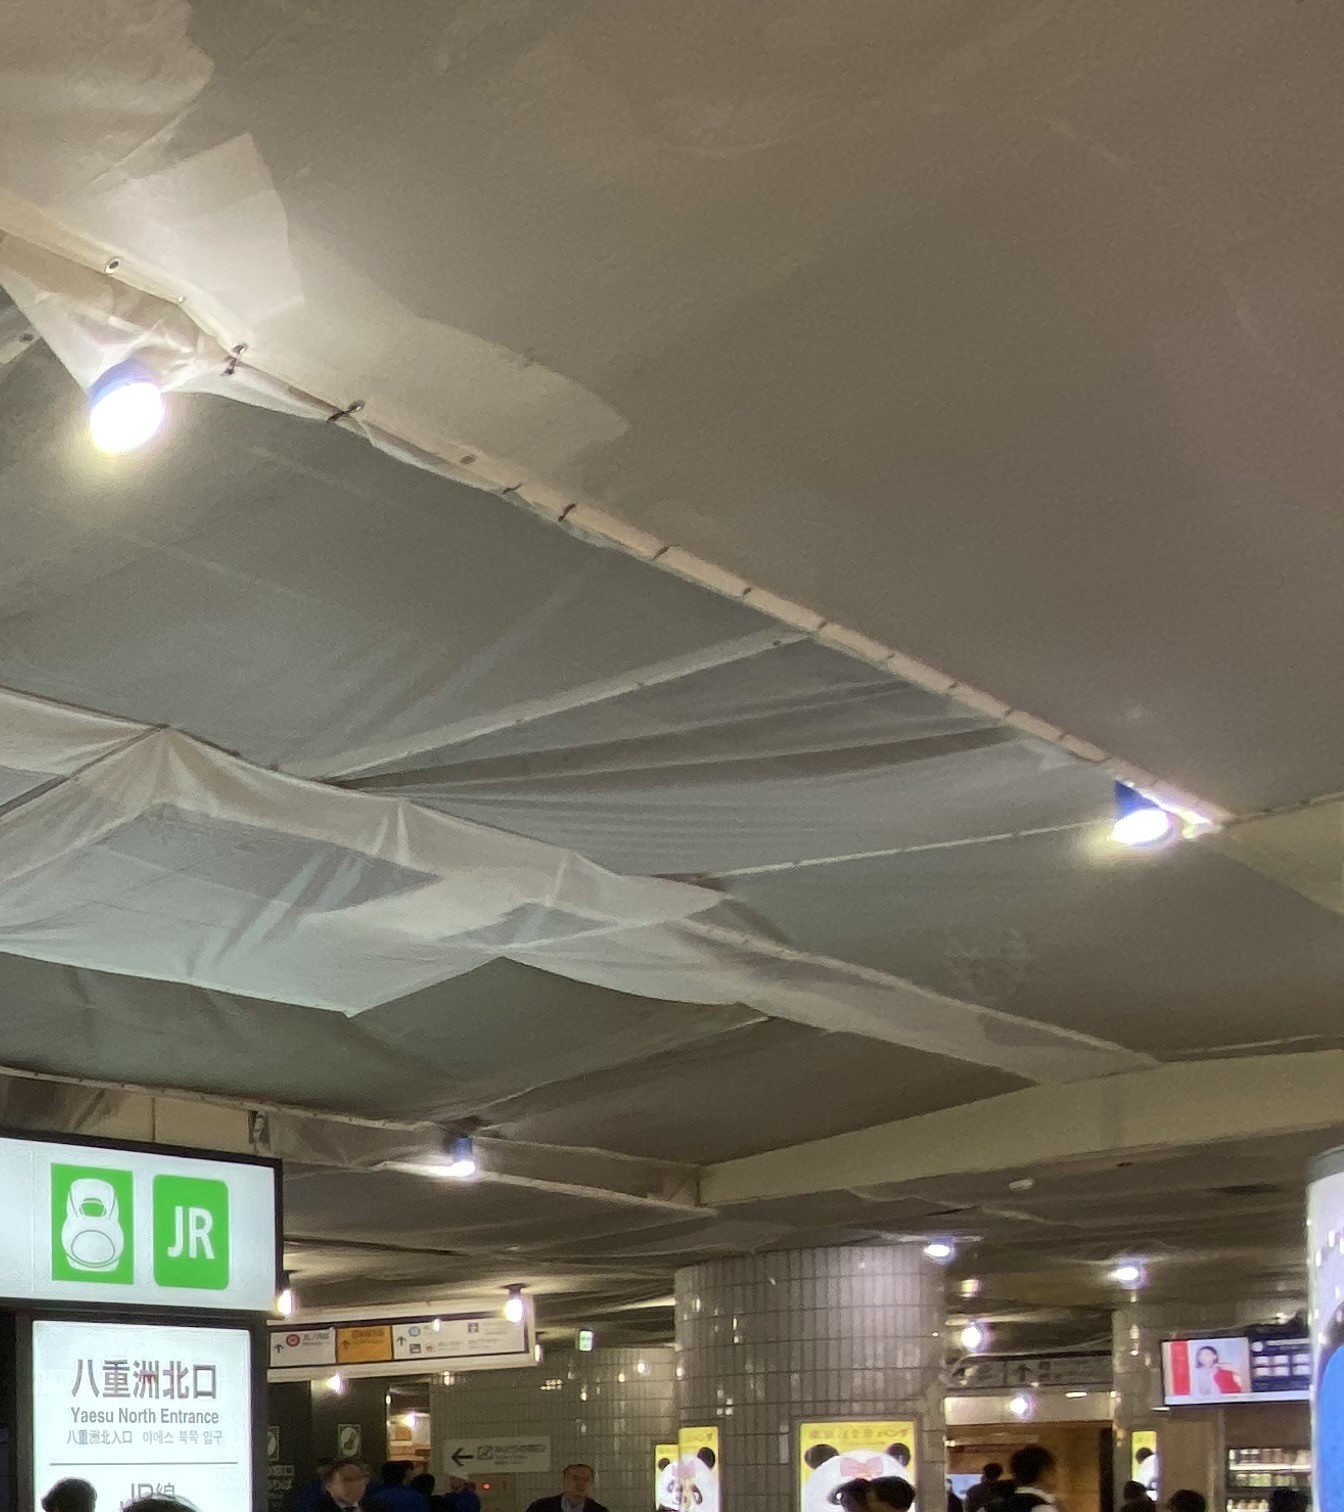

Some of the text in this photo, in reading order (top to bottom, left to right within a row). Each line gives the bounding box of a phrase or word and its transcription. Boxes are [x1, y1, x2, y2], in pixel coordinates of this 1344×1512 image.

[167, 1205, 215, 1260] JR
[70, 1359, 218, 1400] 八重洲北口
[70, 1406, 220, 1425] Yaesu North Entrance
